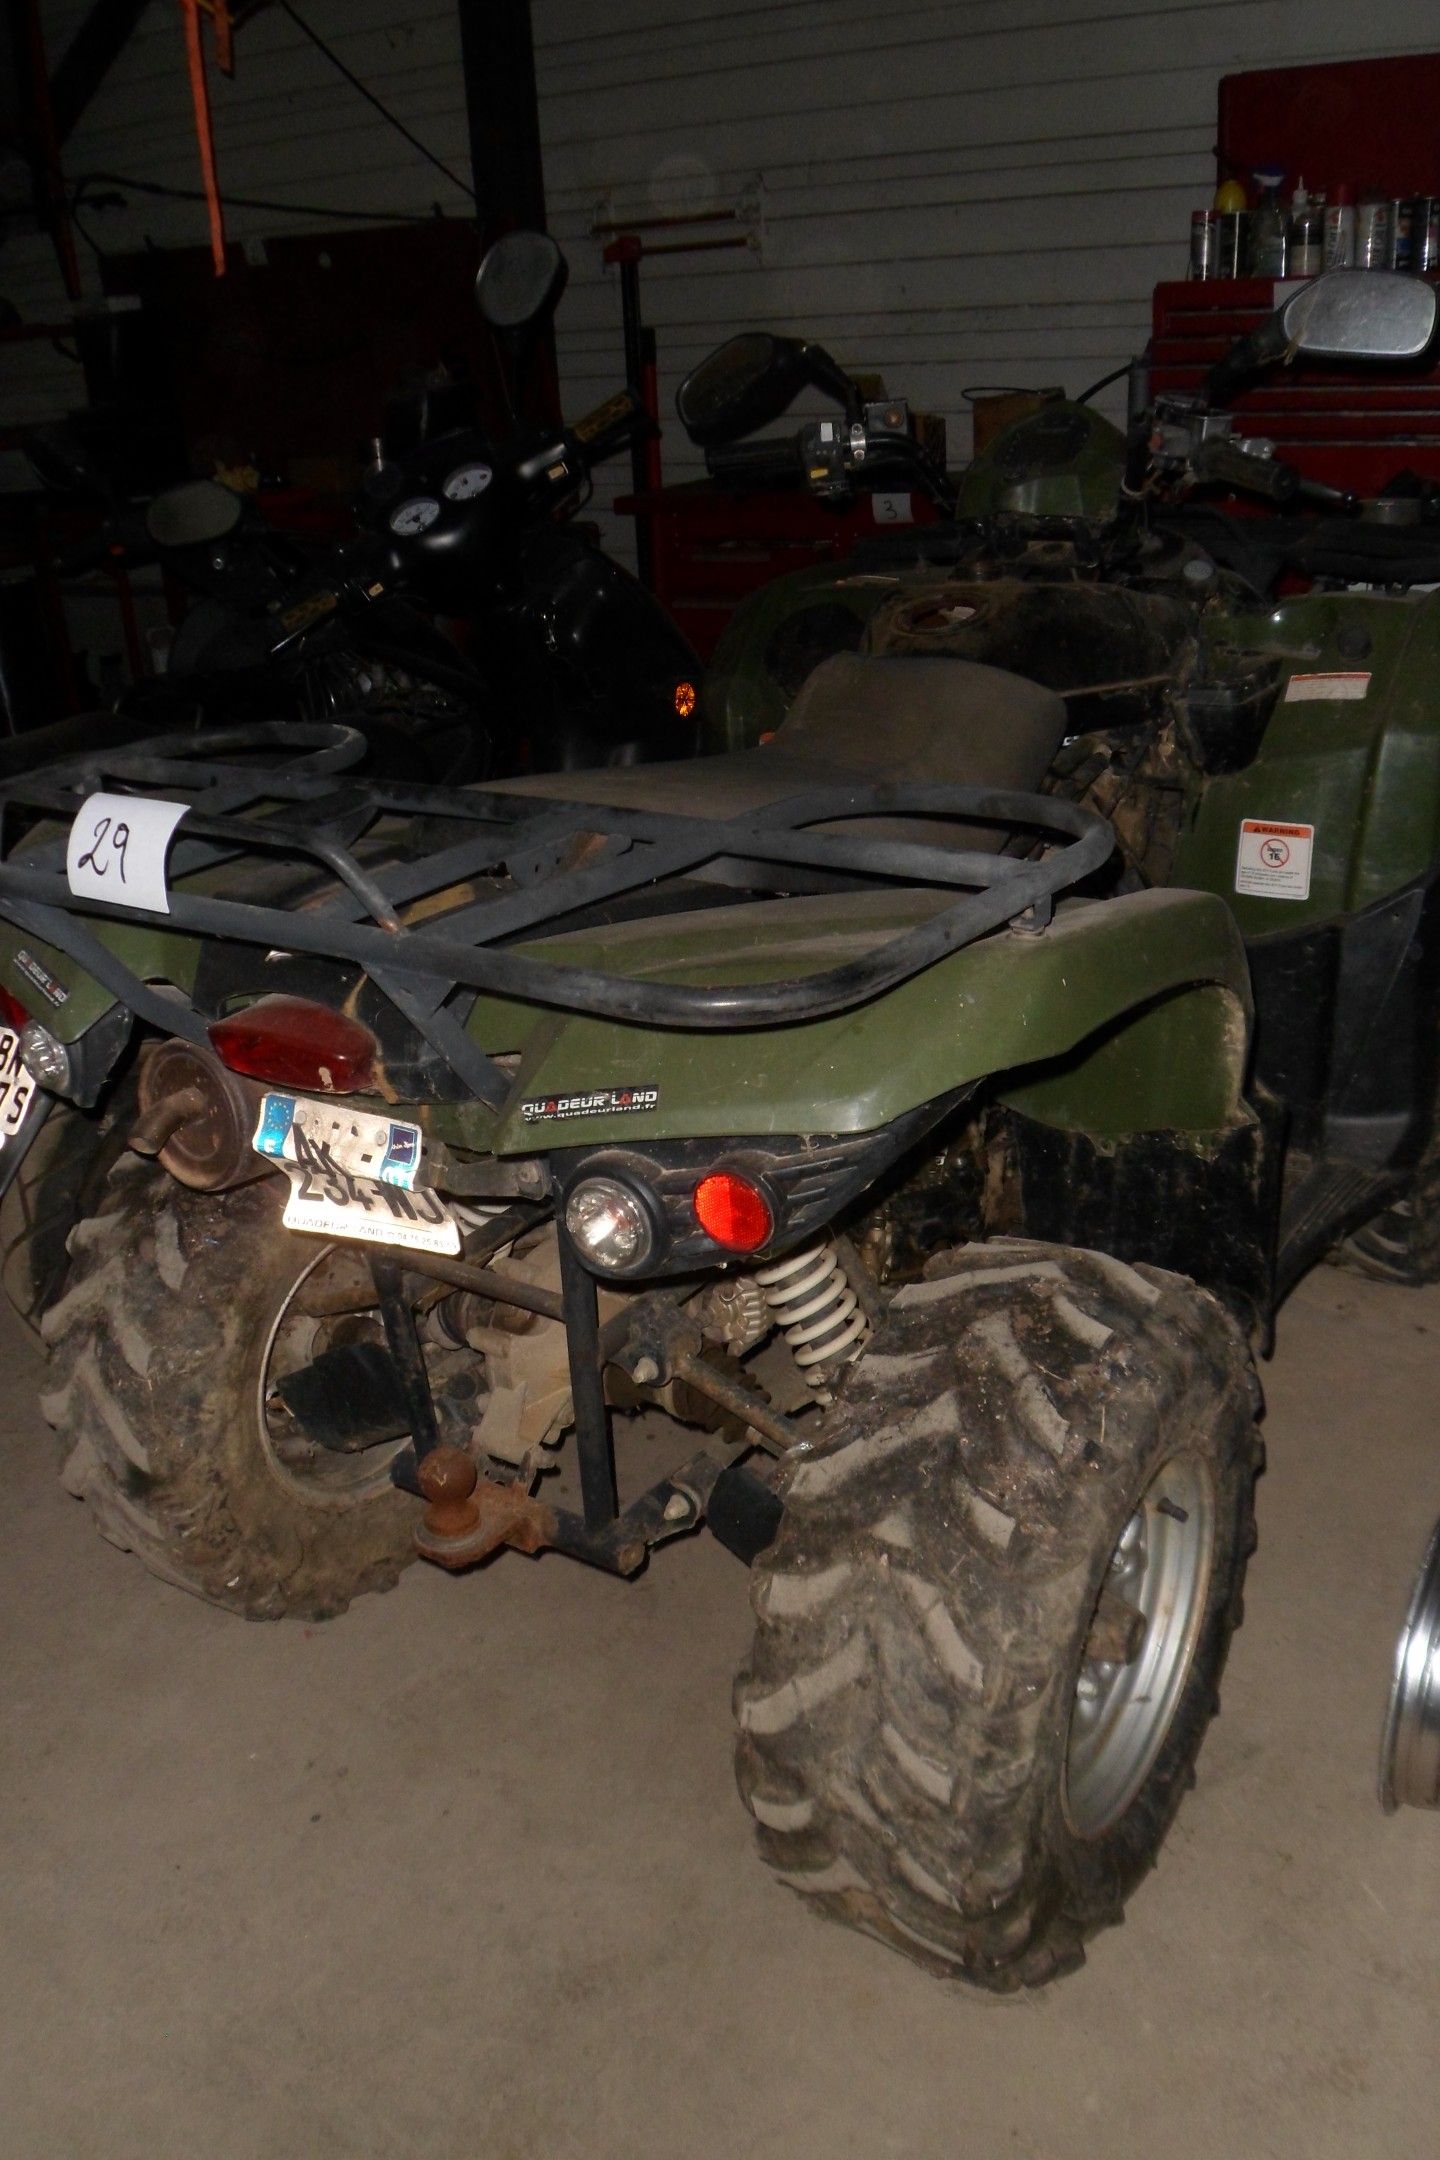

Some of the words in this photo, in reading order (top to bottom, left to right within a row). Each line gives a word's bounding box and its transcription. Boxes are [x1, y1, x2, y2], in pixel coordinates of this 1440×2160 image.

[883, 500, 898, 520] 3
[1262, 826, 1300, 836] WARNING
[77, 817, 130, 884] 29
[521, 1094, 606, 1117] QUADEUR
[611, 1091, 658, 1105] LAND
